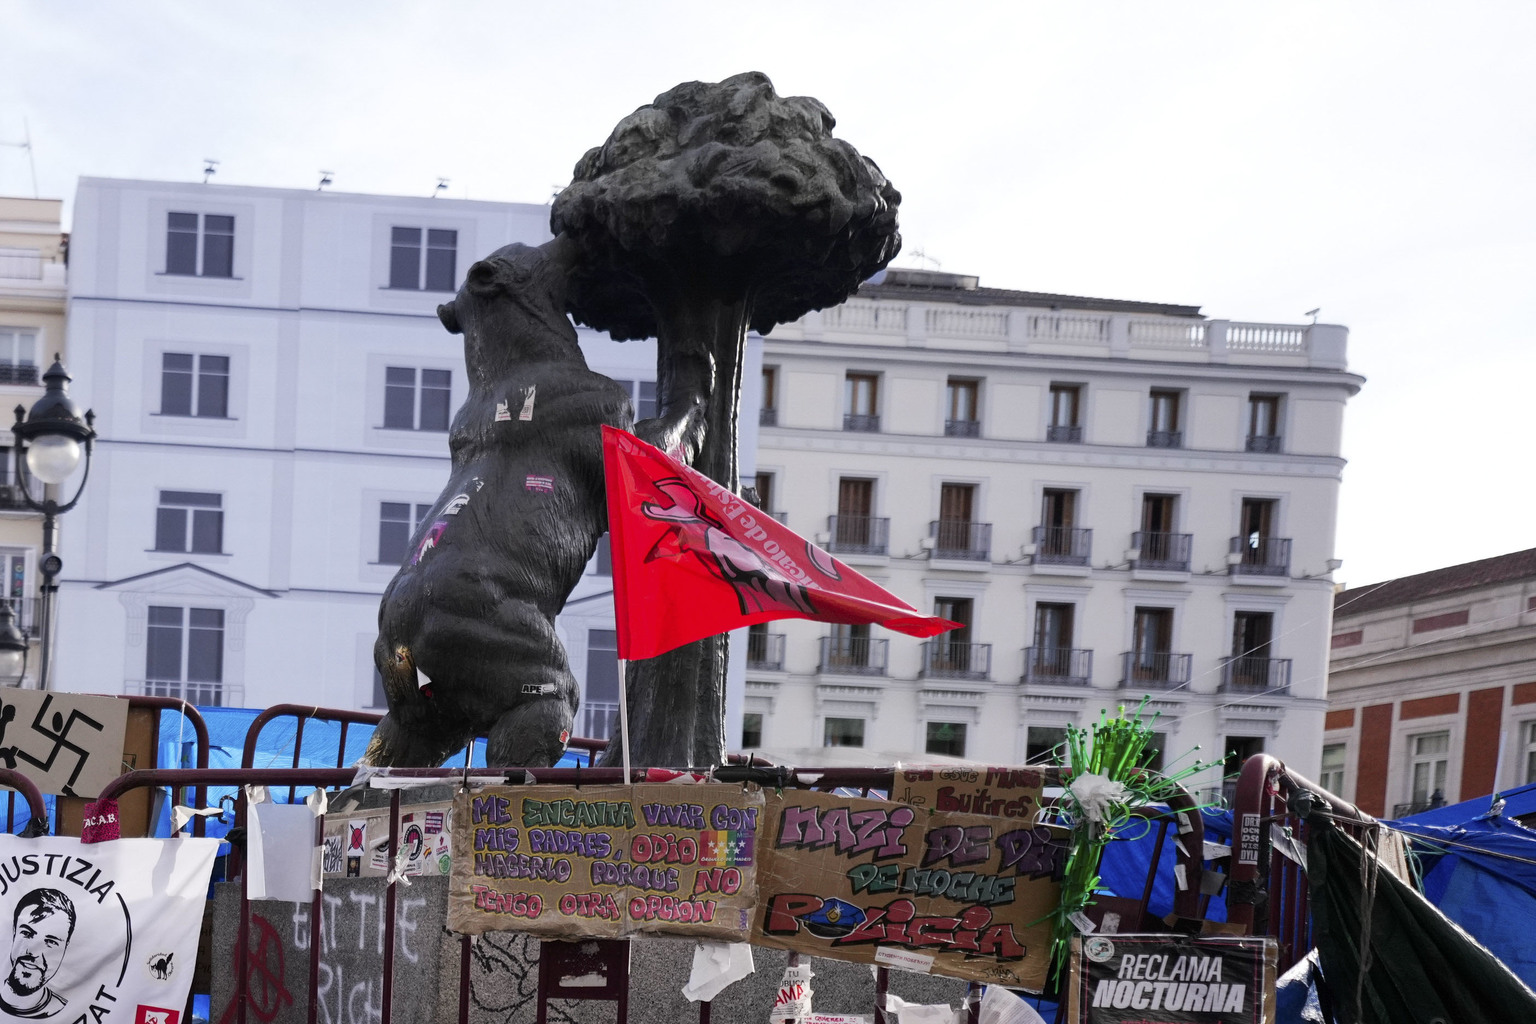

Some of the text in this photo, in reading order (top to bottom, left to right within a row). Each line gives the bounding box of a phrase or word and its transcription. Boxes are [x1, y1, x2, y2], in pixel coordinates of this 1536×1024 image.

[472, 794, 511, 825] ME
[523, 799, 636, 828] ENCANTA
[711, 804, 758, 831] CON
[920, 826, 992, 867] DE
[474, 853, 742, 895] HACERLO PORQUE NO
[847, 863, 1016, 904] DE NOCHE
[470, 885, 543, 919] TENGO
[559, 894, 621, 921] OTRA
[1118, 954, 1222, 982] RECLAMA
[1092, 979, 1246, 1013] NOCTURNA
